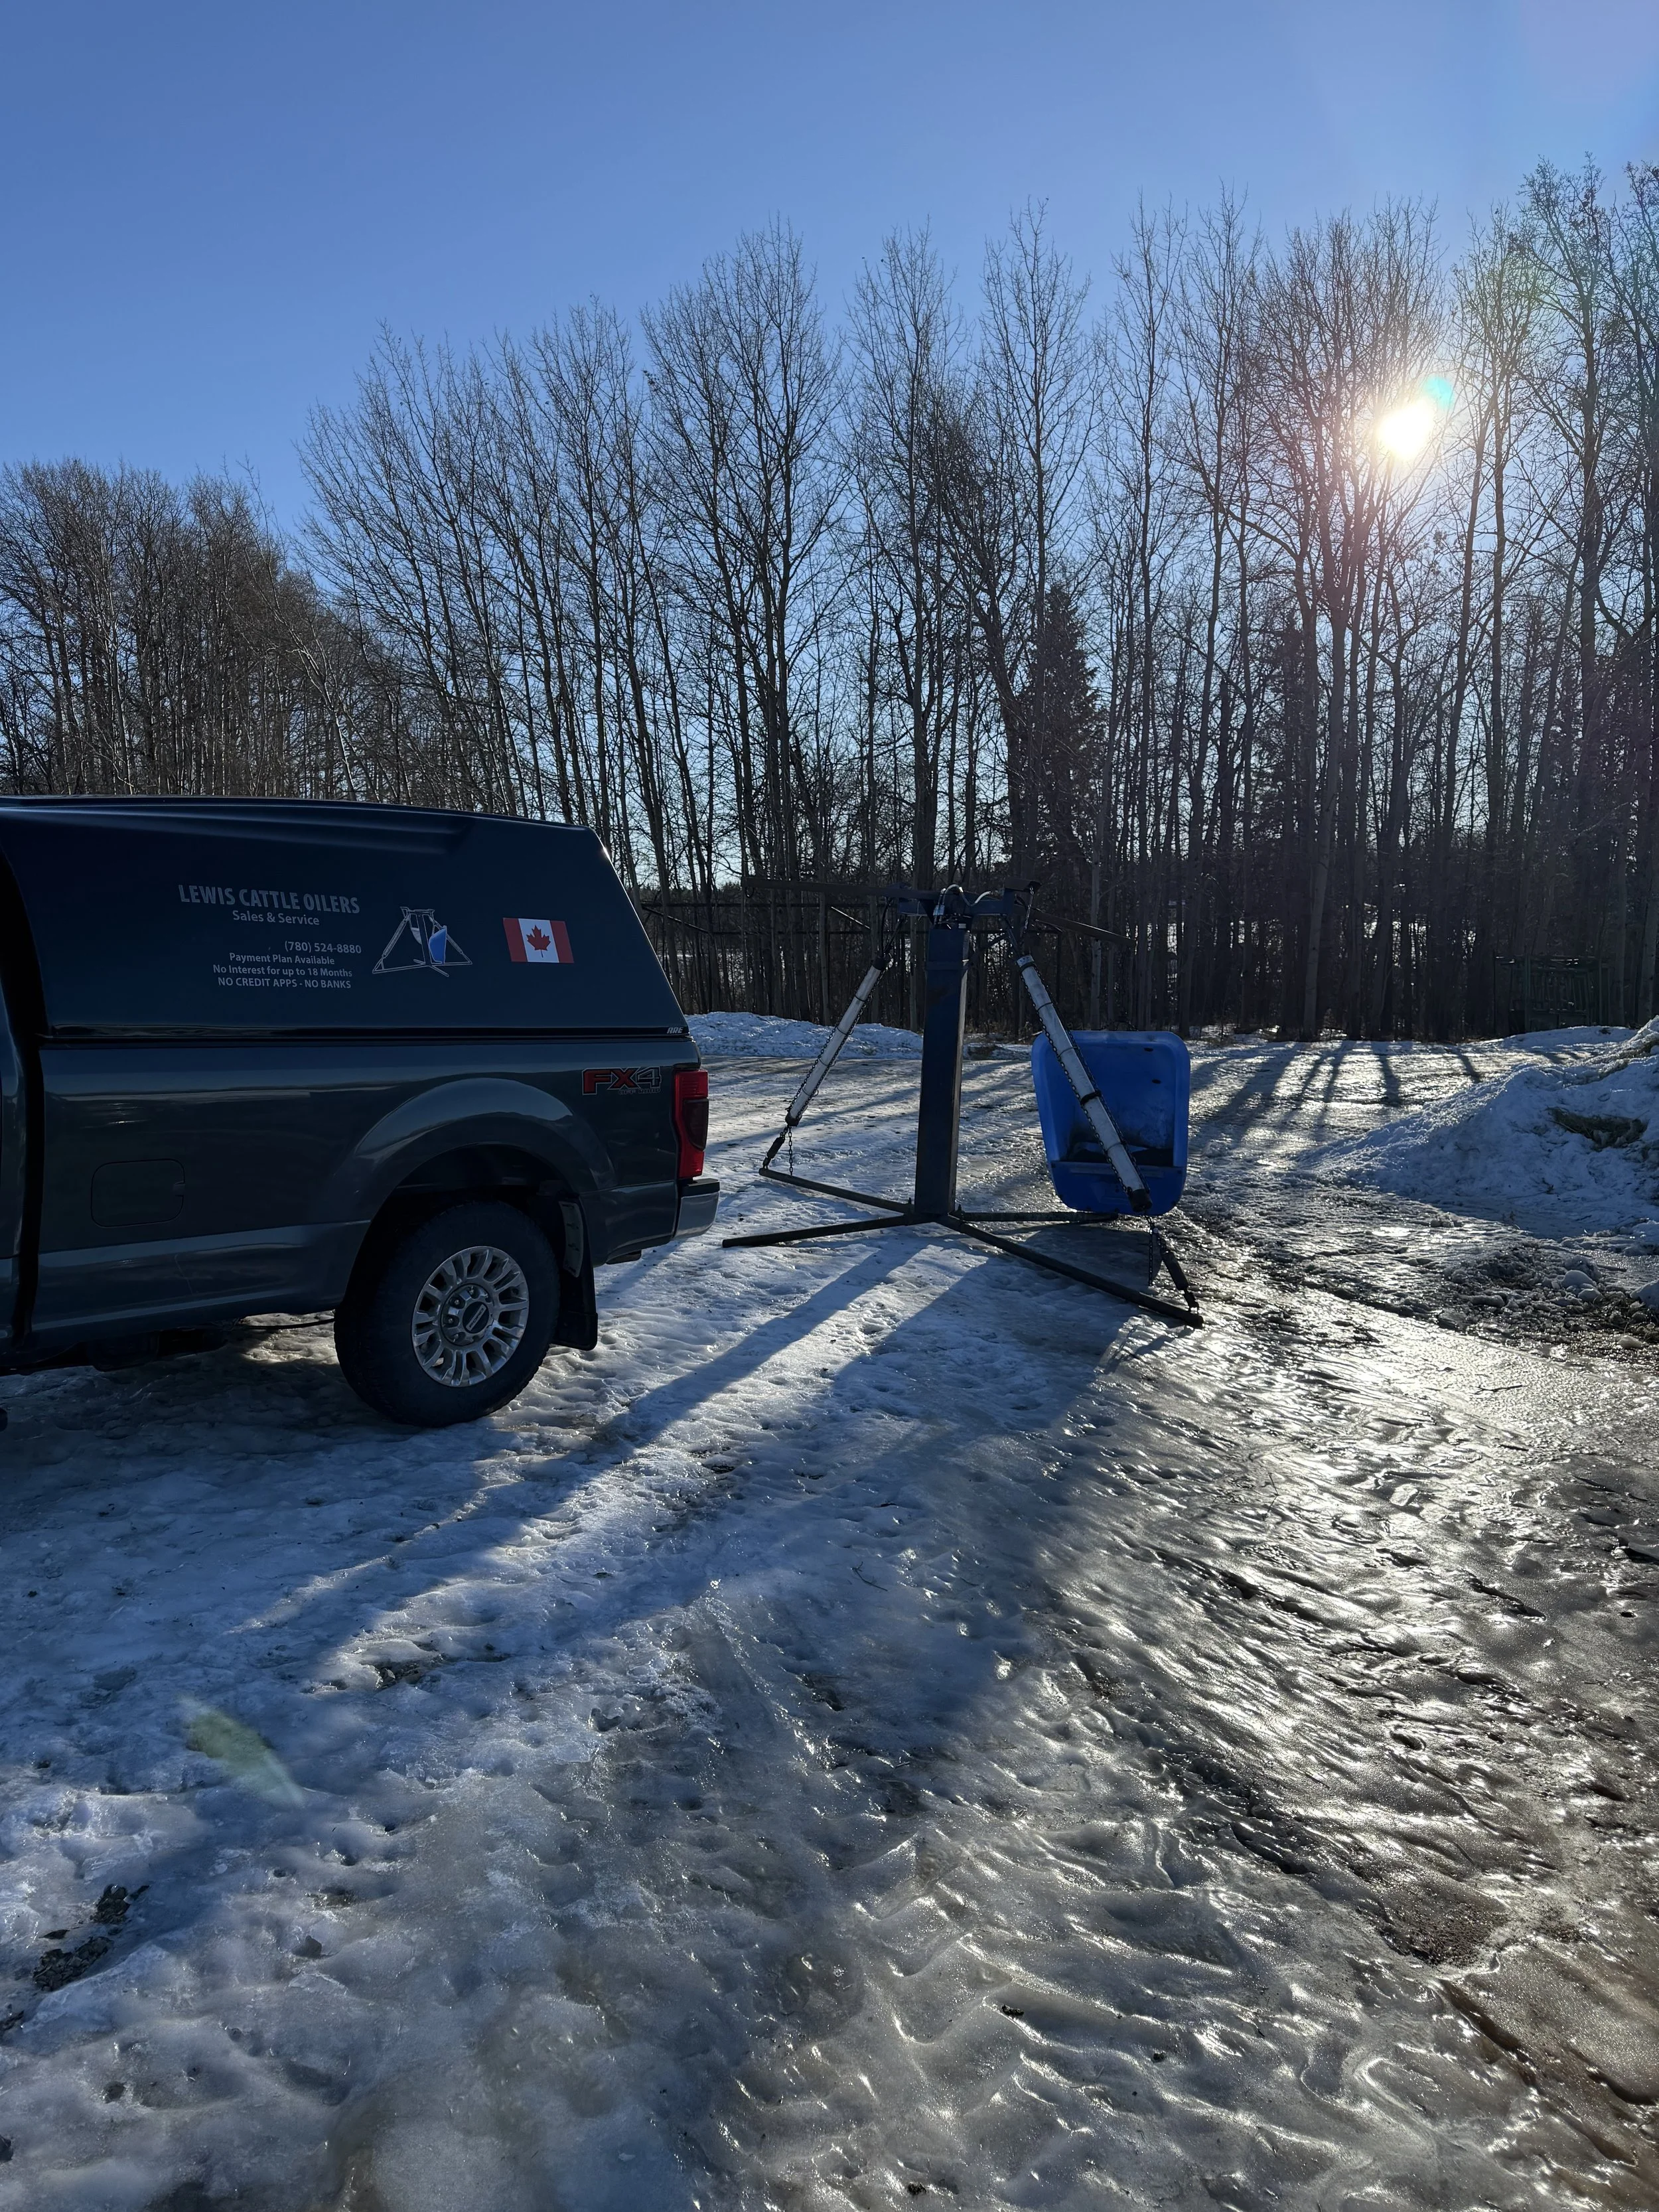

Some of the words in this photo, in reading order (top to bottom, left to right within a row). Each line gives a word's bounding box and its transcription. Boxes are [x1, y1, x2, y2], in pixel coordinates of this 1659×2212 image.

[179, 885, 236, 906] LEWIS
[239, 889, 301, 910] CATTLE
[303, 893, 360, 914] OILERS
[232, 910, 264, 922] Sales
[267, 912, 276, 922] &
[277, 913, 320, 925] Service
[285, 940, 312, 953] (780)
[314, 942, 362, 954] 524-8880
[229, 952, 271, 964] Payment
[272, 954, 292, 964] Plan
[295, 956, 335, 965] Available
[213, 964, 227, 974] No
[228, 965, 265, 974] Interest
[267, 966, 281, 975] for
[282, 968, 294, 977] up
[296, 968, 306, 976] to
[307, 968, 319, 976] 18
[320, 968, 353, 977] Months
[218, 977, 234, 986] NO
[236, 978, 271, 987] CREDIT
[273, 979, 298, 988] APPS
[305, 980, 319, 988] NO
[321, 980, 351, 989] BANKS
[581, 1067, 662, 1095] FX4
